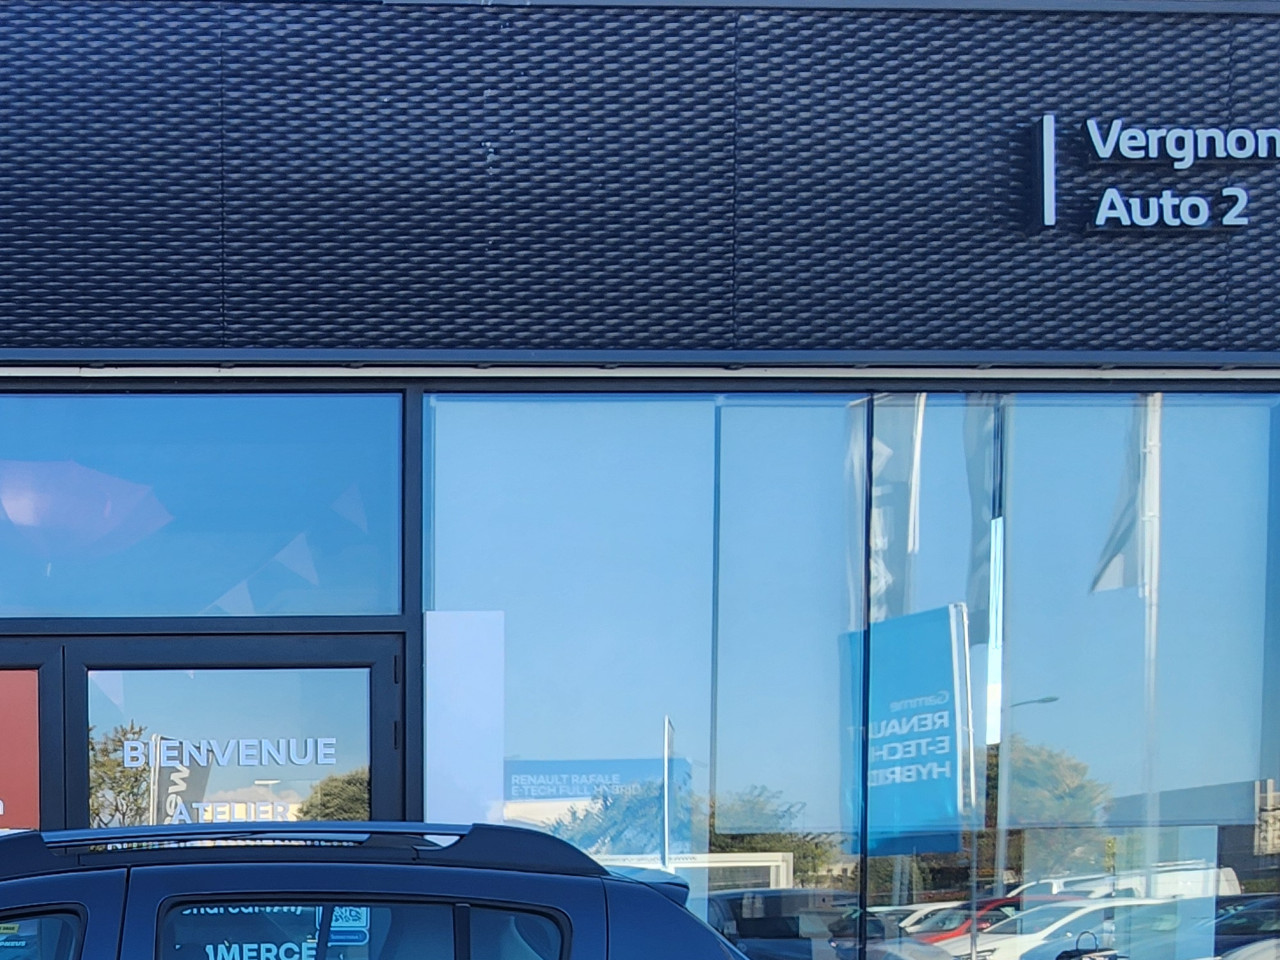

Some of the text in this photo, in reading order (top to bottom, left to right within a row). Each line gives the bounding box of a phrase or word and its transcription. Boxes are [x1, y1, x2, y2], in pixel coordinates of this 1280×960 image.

[1086, 119, 1280, 170] Vergnon
[1095, 187, 1250, 227] Auto 2
[123, 737, 337, 768] BIENVENUE
[511, 774, 621, 786] RENAULT RAFALE
[559, 785, 591, 796] FULL
[171, 801, 291, 824] ATELIER
